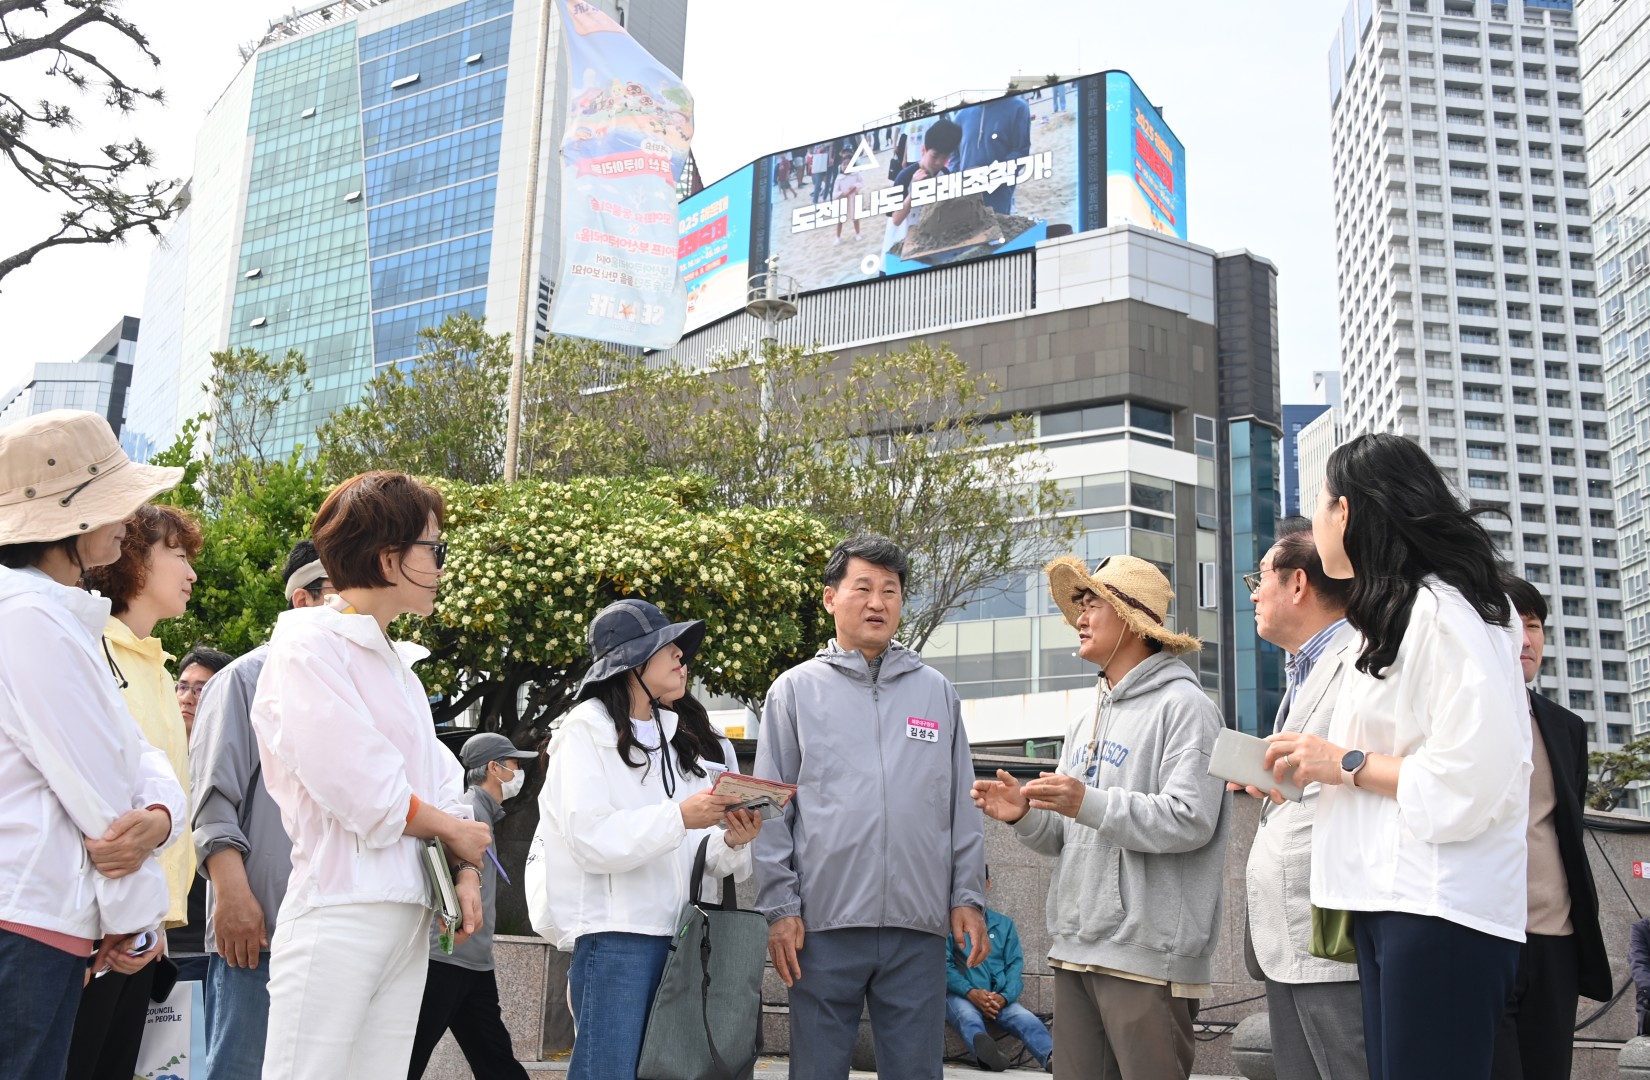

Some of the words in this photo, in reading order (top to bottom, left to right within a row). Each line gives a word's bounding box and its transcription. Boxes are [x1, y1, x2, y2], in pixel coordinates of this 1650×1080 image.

[791, 198, 848, 233] 도전!
[854, 184, 904, 219] 나도
[679, 212, 699, 234] 025
[910, 727, 935, 740] 김성수
[155, 1014, 183, 1023] PEOPLE
